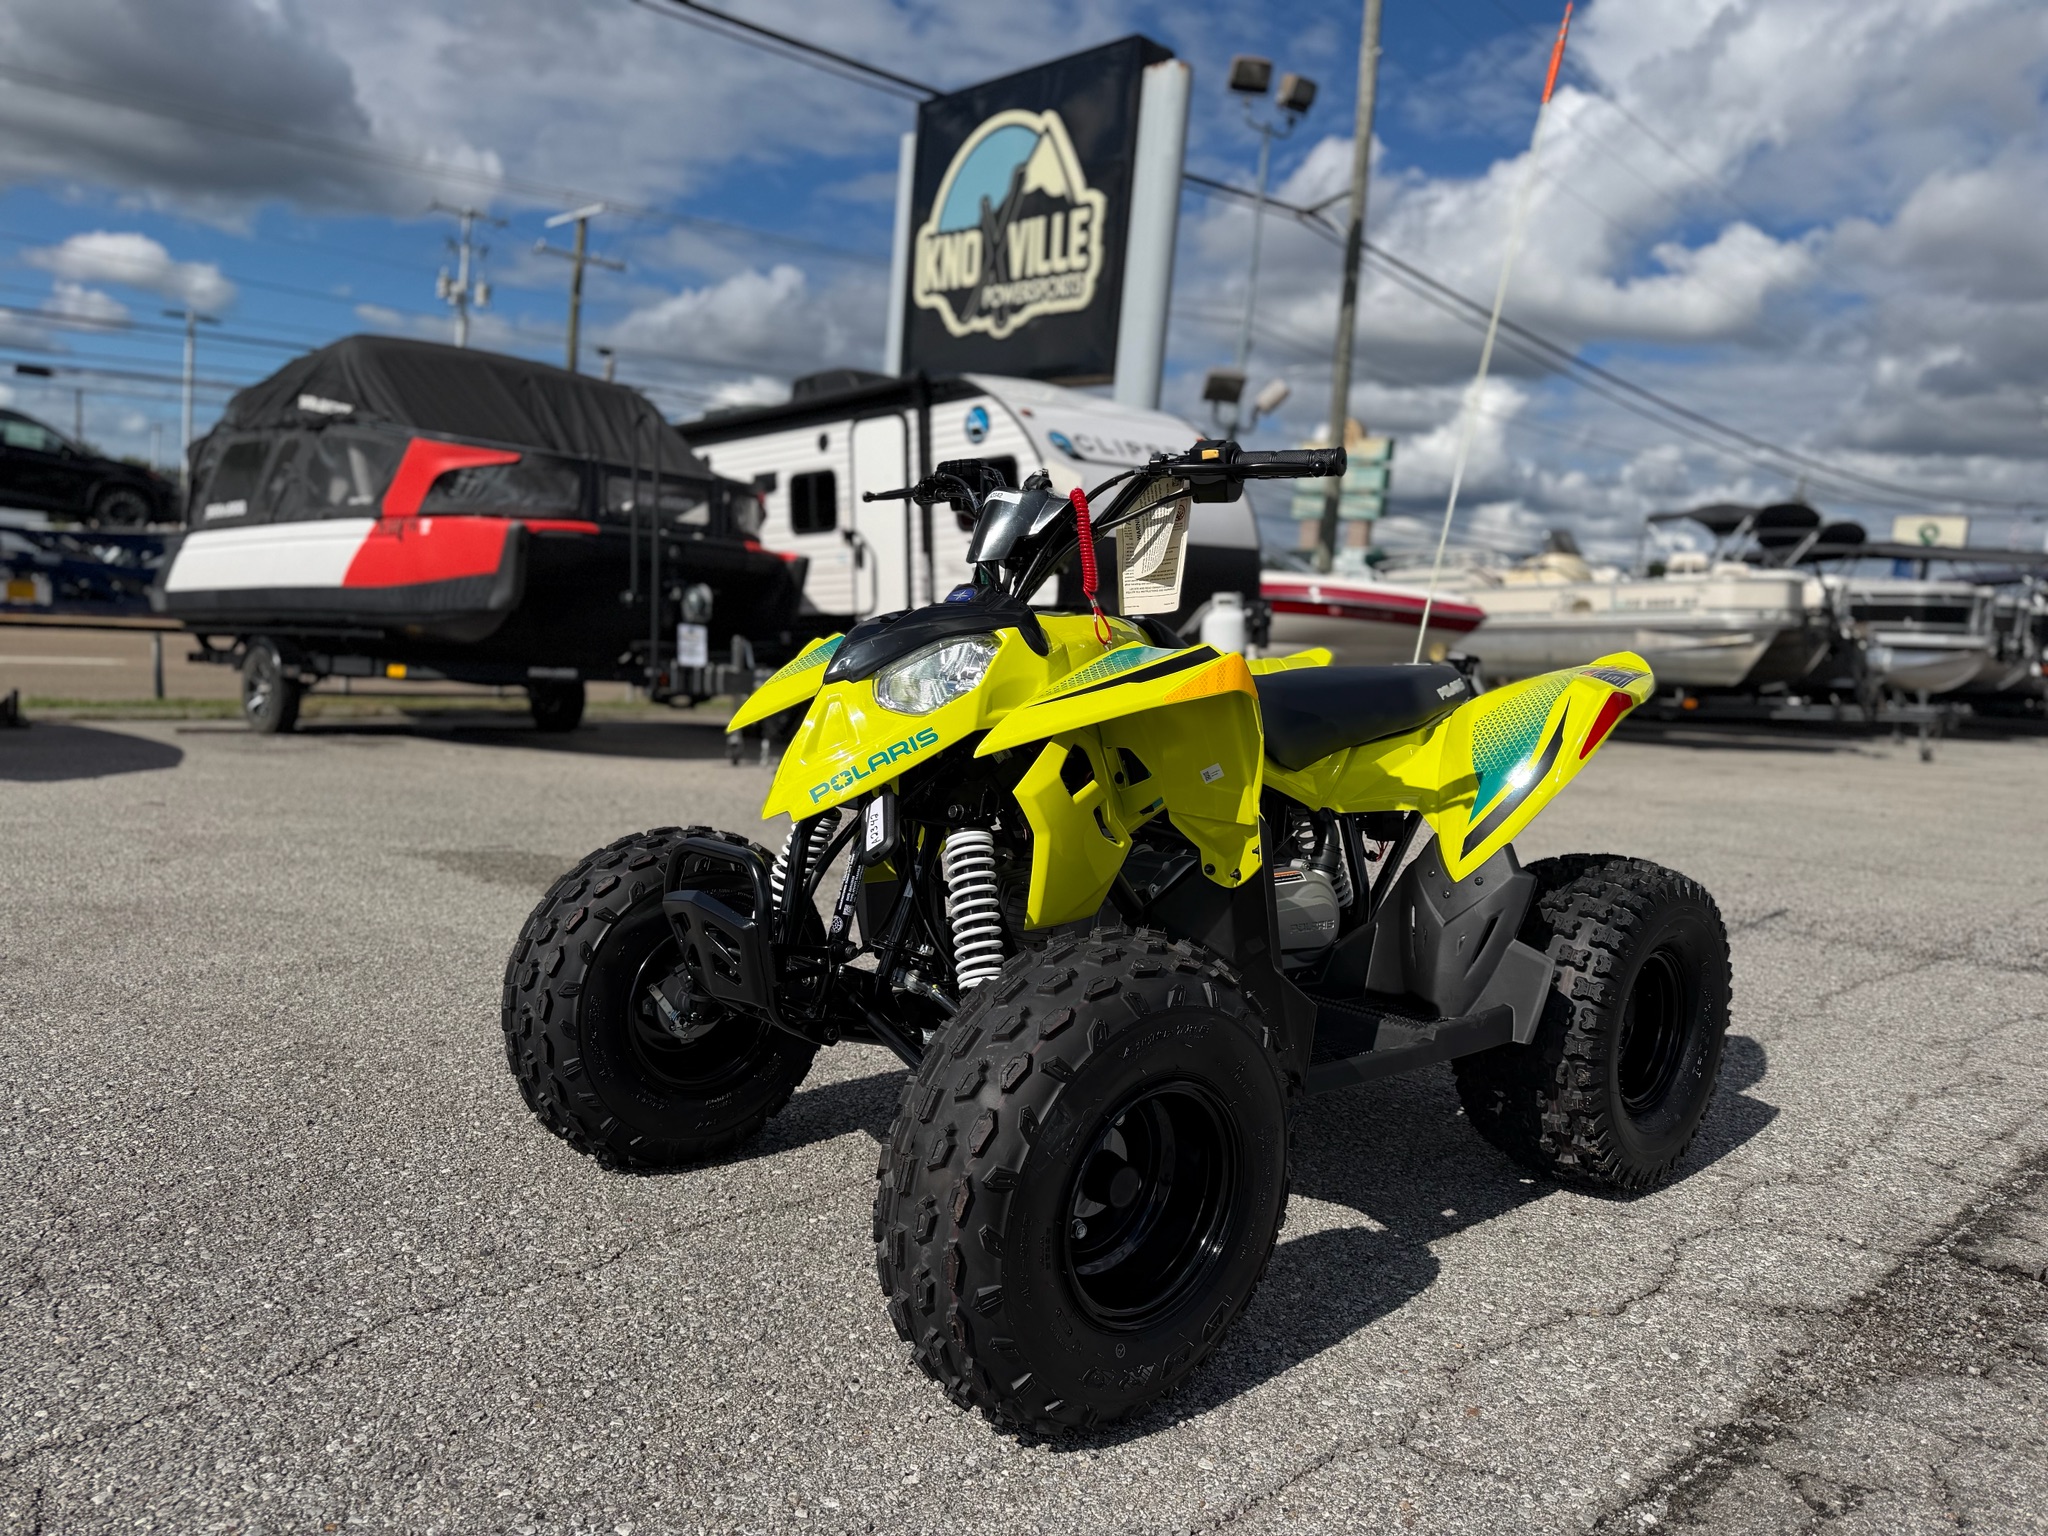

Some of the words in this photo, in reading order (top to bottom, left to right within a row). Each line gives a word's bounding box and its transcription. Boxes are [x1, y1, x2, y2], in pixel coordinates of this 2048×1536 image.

[923, 178, 1093, 318] KNOXVILLE
[980, 271, 1085, 309] POWERSPORTS
[809, 727, 939, 804] POLARIS
[870, 813, 881, 844] A2342
